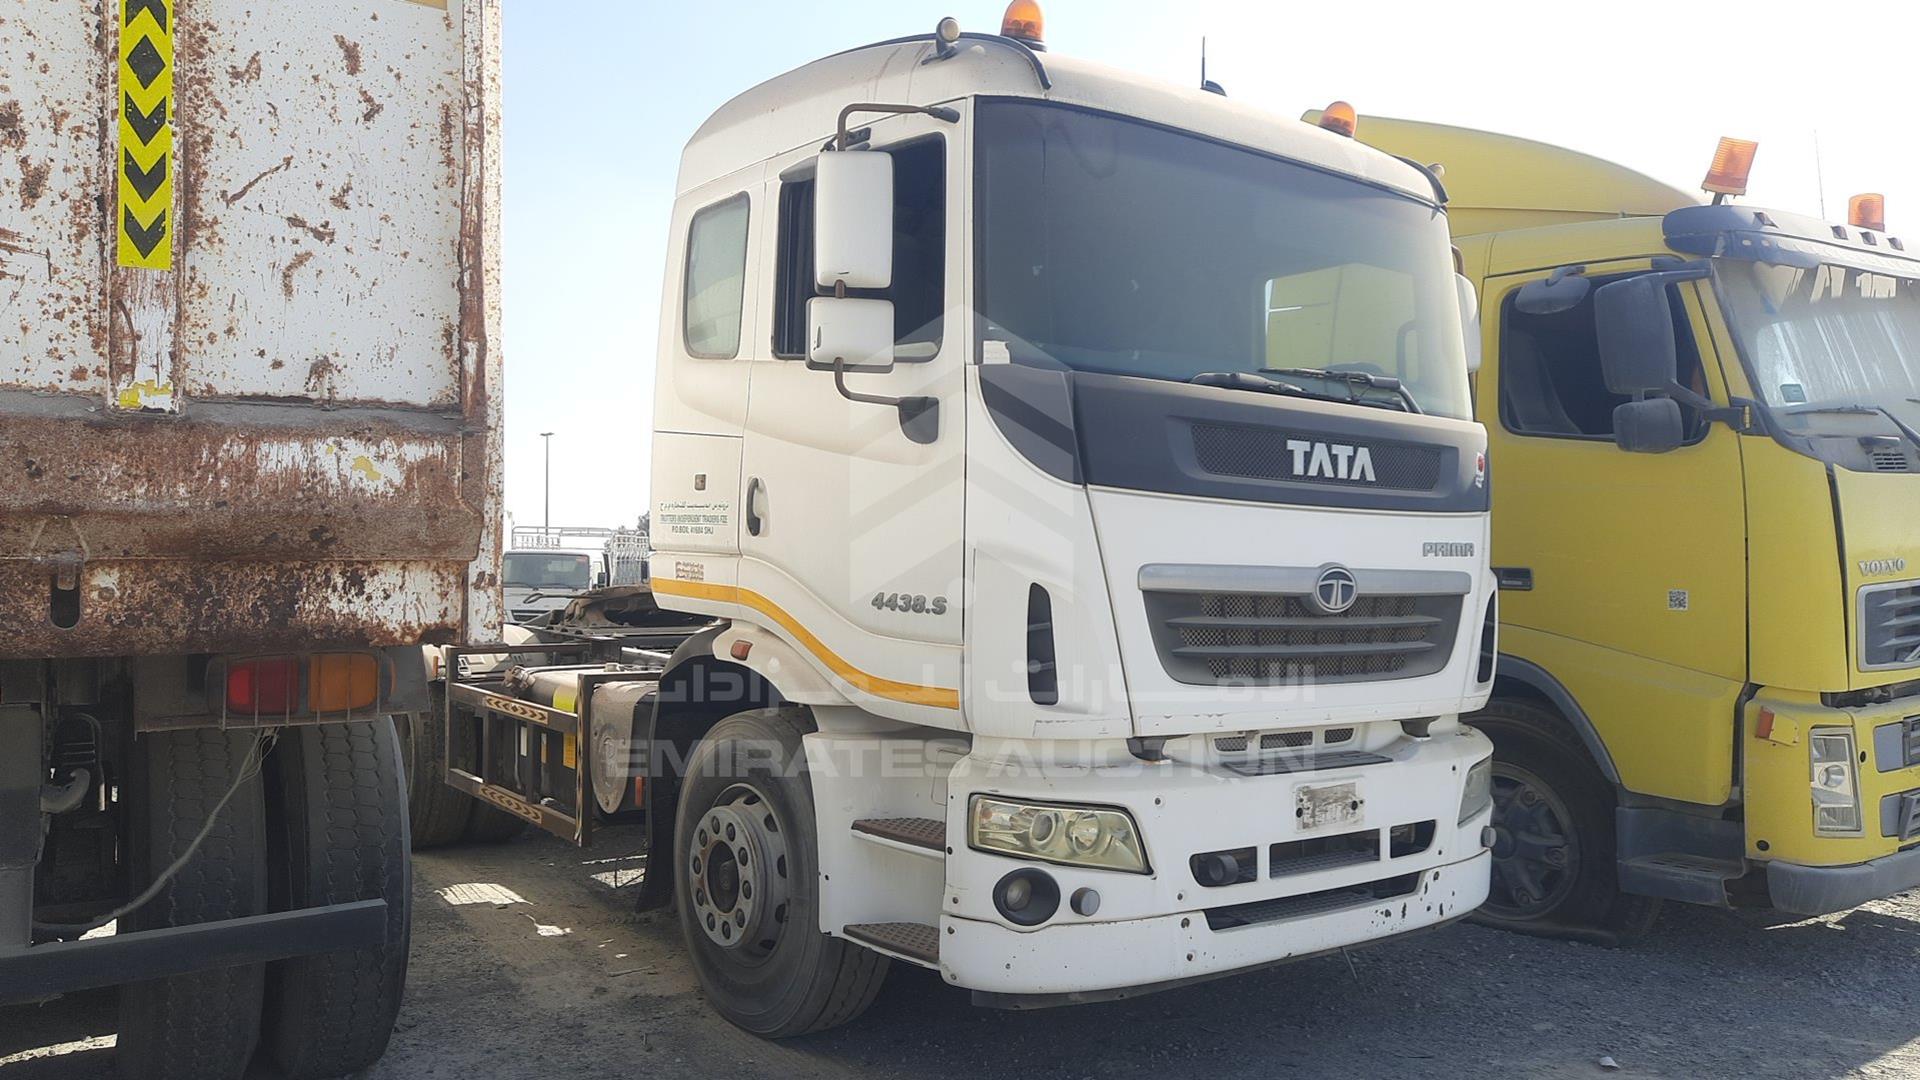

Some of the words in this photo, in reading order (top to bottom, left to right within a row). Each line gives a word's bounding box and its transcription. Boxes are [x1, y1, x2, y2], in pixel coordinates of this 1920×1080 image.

[1286, 440, 1377, 482] TATA
[1422, 542, 1475, 558] PRIMA
[1857, 559, 1905, 577] VOLVO
[871, 592, 948, 616] 4438.S
